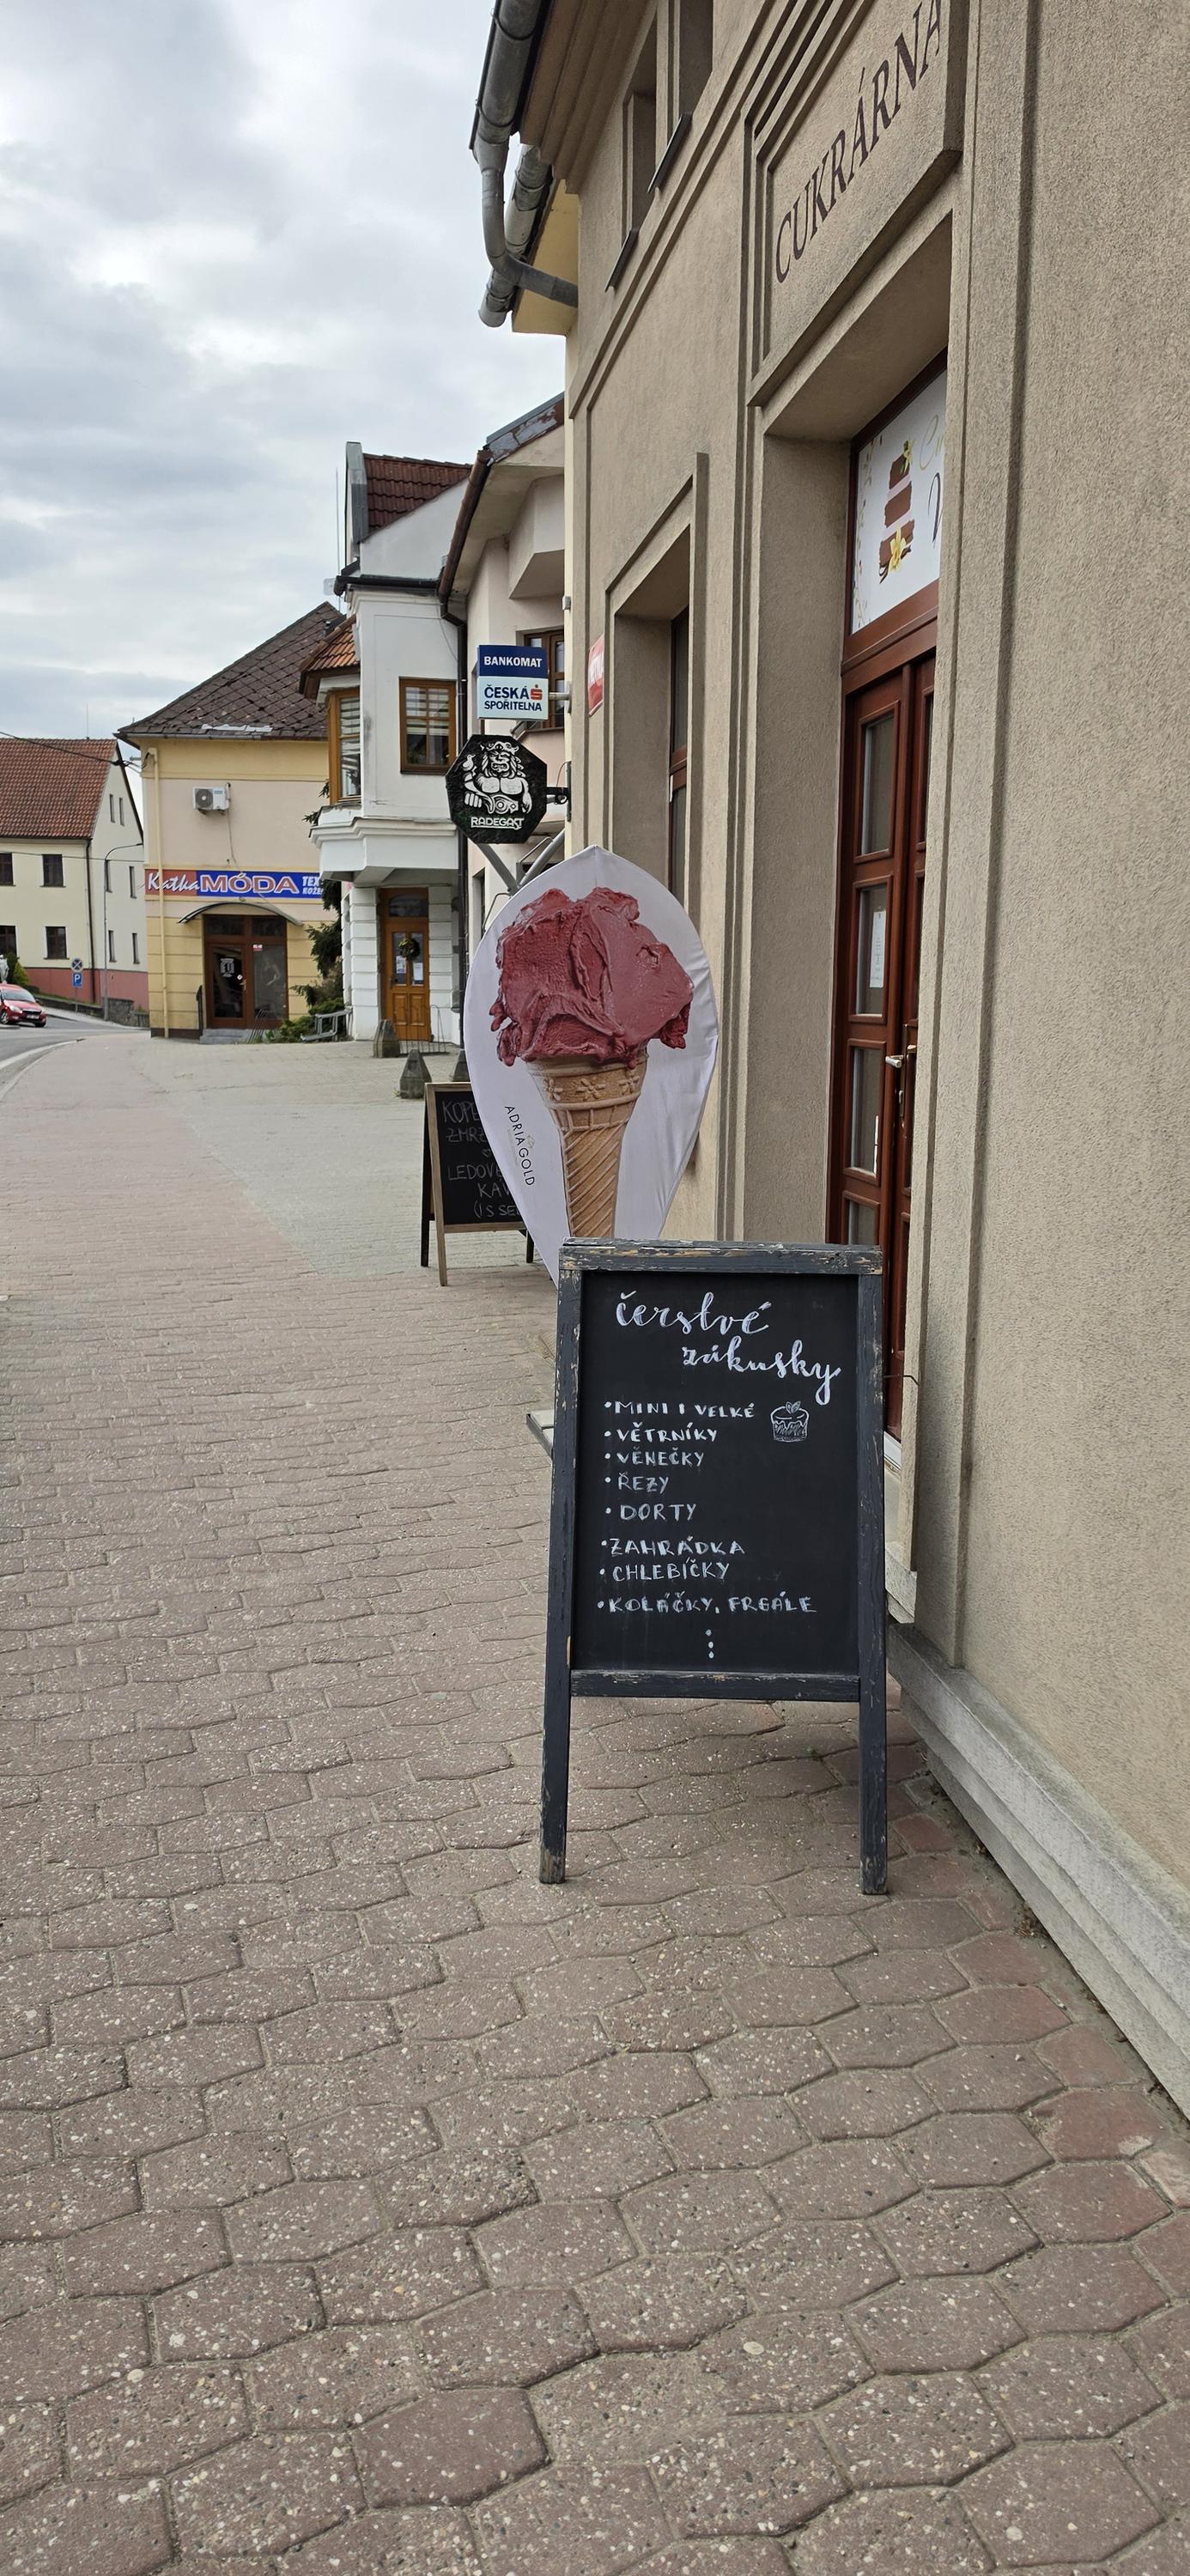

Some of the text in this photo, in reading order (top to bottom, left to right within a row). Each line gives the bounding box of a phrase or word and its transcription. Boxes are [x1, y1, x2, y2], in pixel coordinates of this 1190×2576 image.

[775, 0, 942, 283] CUKRÁRNA
[483, 655, 543, 668] BANKOMAT
[483, 684, 530, 700] ČESKÁ
[483, 699, 543, 712] SPOŘITELNA
[471, 817, 525, 830] RADEGAST
[147, 872, 201, 892] Katka
[200, 872, 300, 894] MÓDA
[74, 974, 81, 983] P
[498, 1205, 521, 1217] SE
[616, 1290, 773, 1334] čerstvé
[681, 1334, 842, 1406] zákusky
[615, 1400, 669, 1415] MINI
[694, 1402, 756, 1419] VELKÉ
[616, 1421, 718, 1443] VĚTRNÍKY
[616, 1446, 705, 1467] VĚNEČKY
[617, 1471, 670, 1494] ŘEZY
[620, 1504, 697, 1522] DORTY
[609, 1535, 746, 1557] ZAHRÁDKA
[612, 1557, 730, 1582] CHLEBÍČKY
[728, 1591, 817, 1613] FRGÁLE
